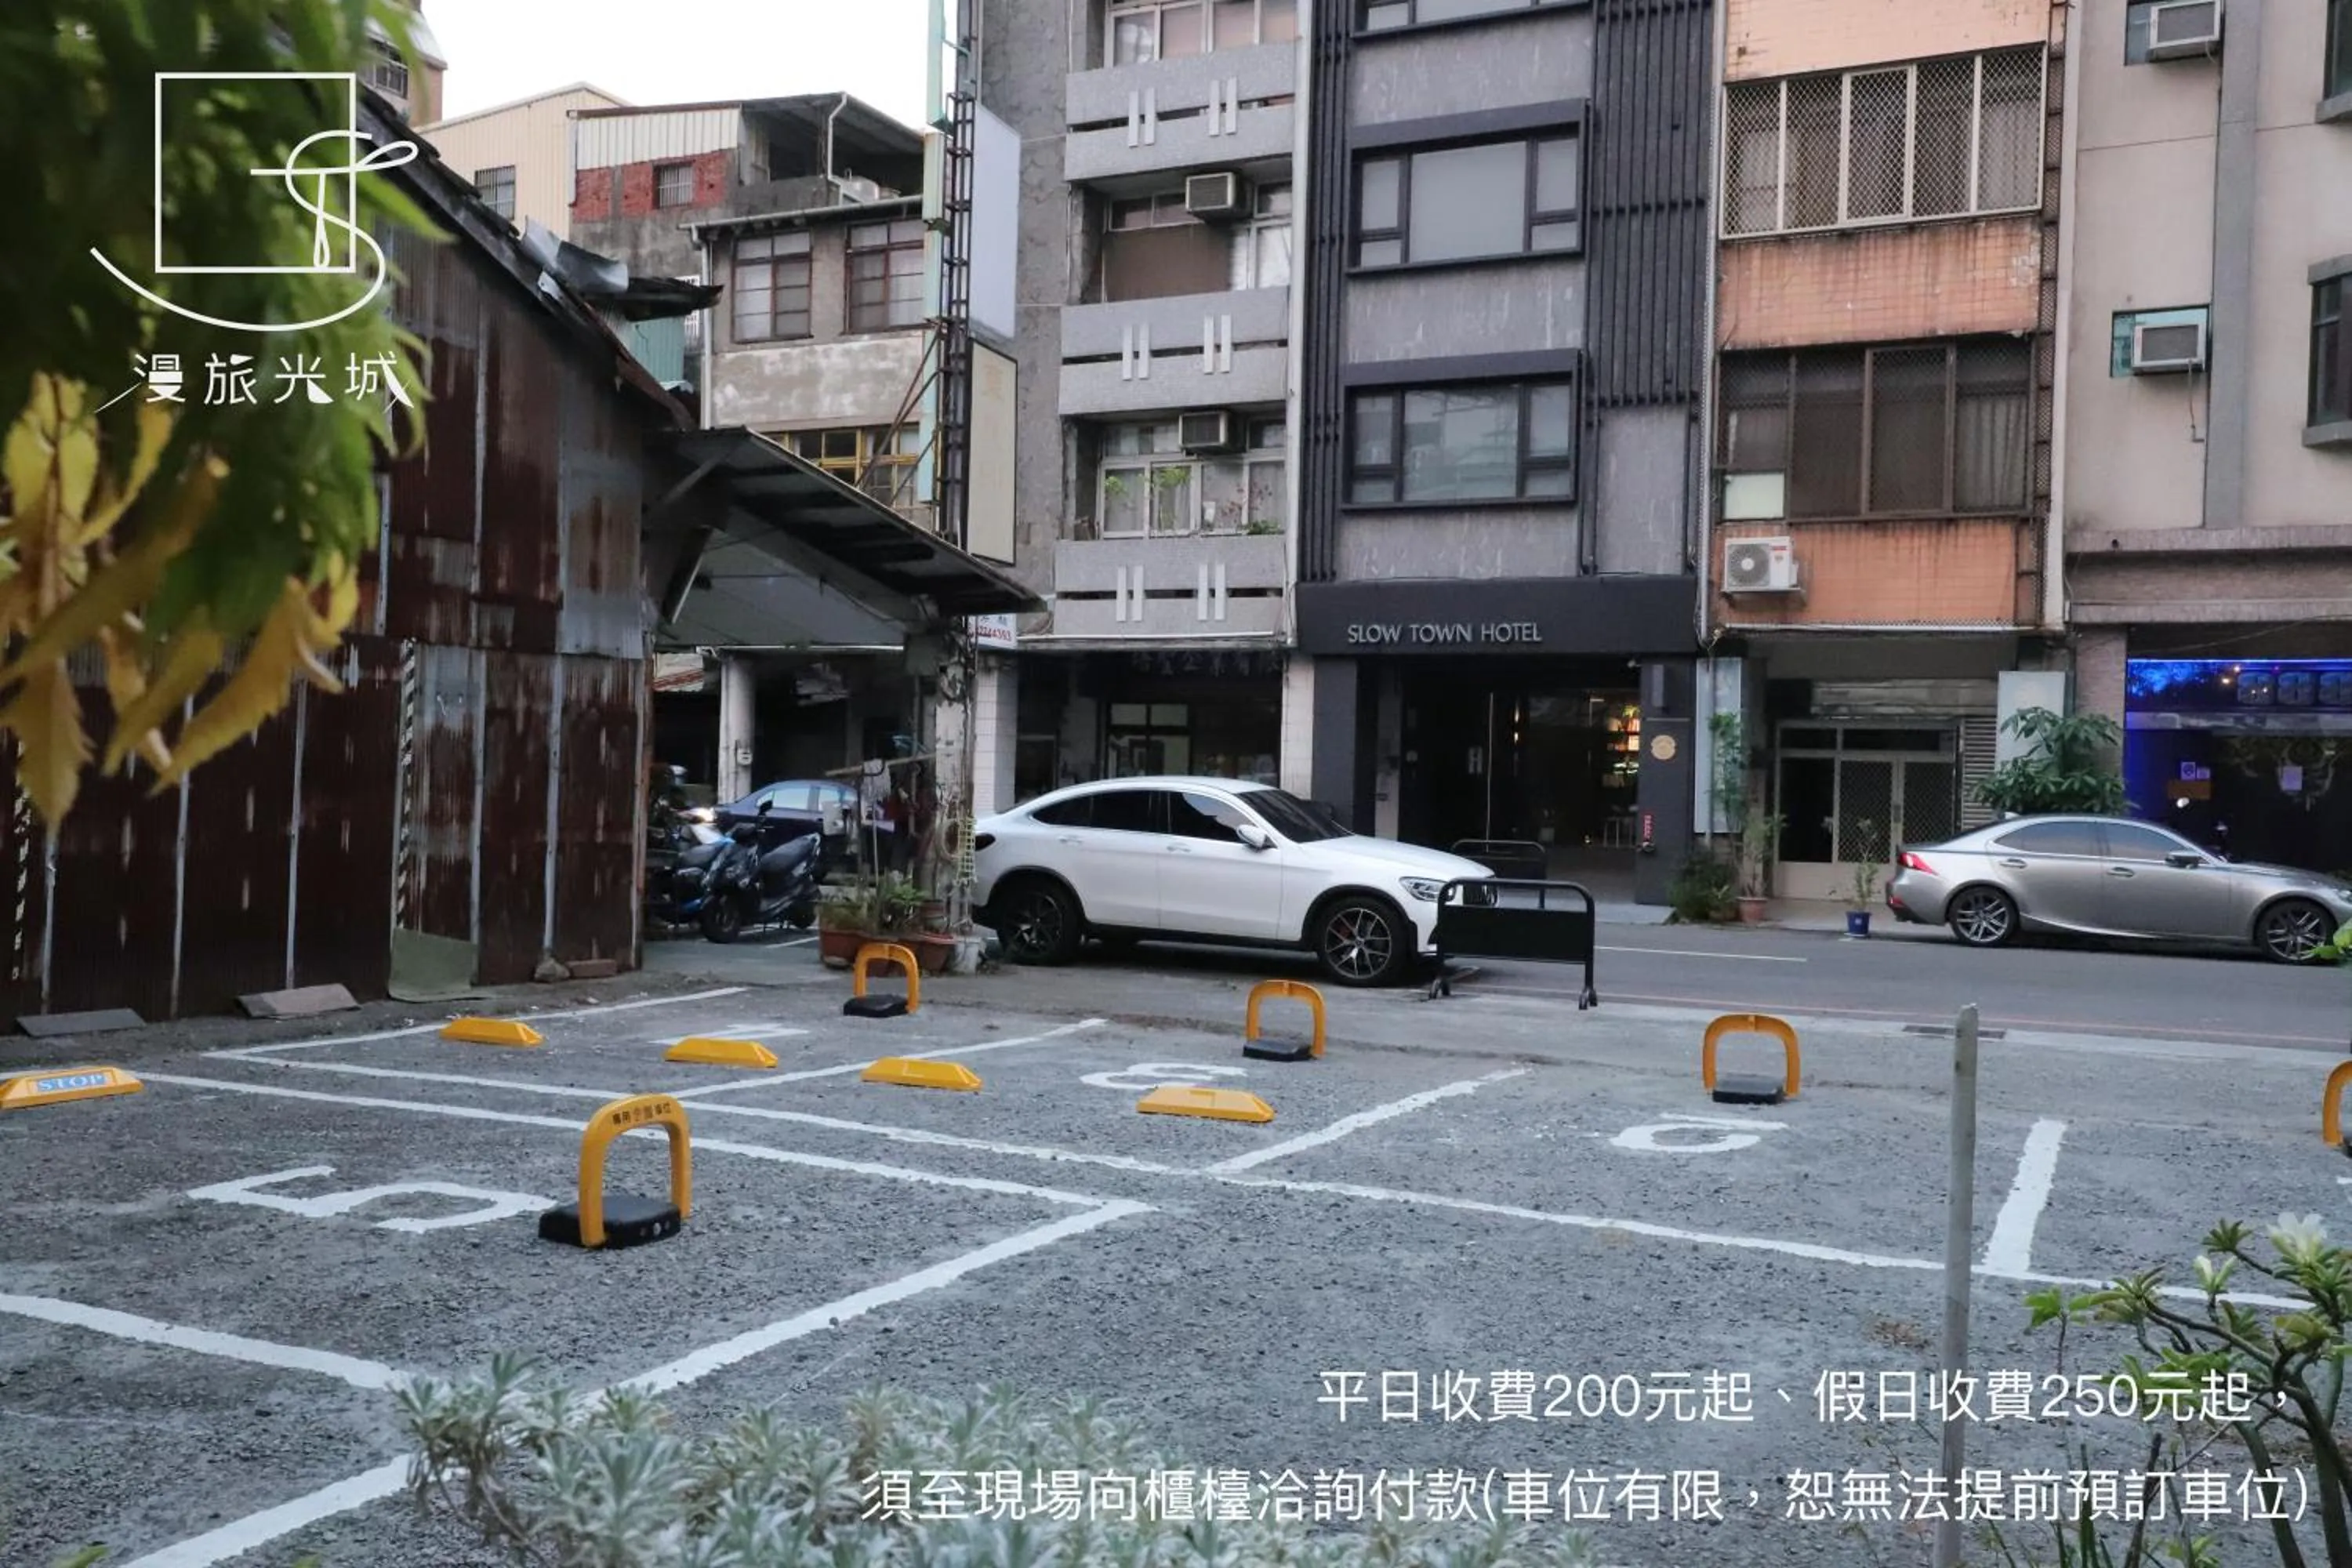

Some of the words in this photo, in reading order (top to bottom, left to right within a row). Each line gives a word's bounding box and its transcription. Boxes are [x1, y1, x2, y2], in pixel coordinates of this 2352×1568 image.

[1347, 624, 1403, 644] SLOW
[1408, 622, 1473, 643] TOWN
[1480, 622, 1543, 642] HOTEL
[39, 1074, 103, 1091] STOP
[188, 1165, 557, 1233] 5
